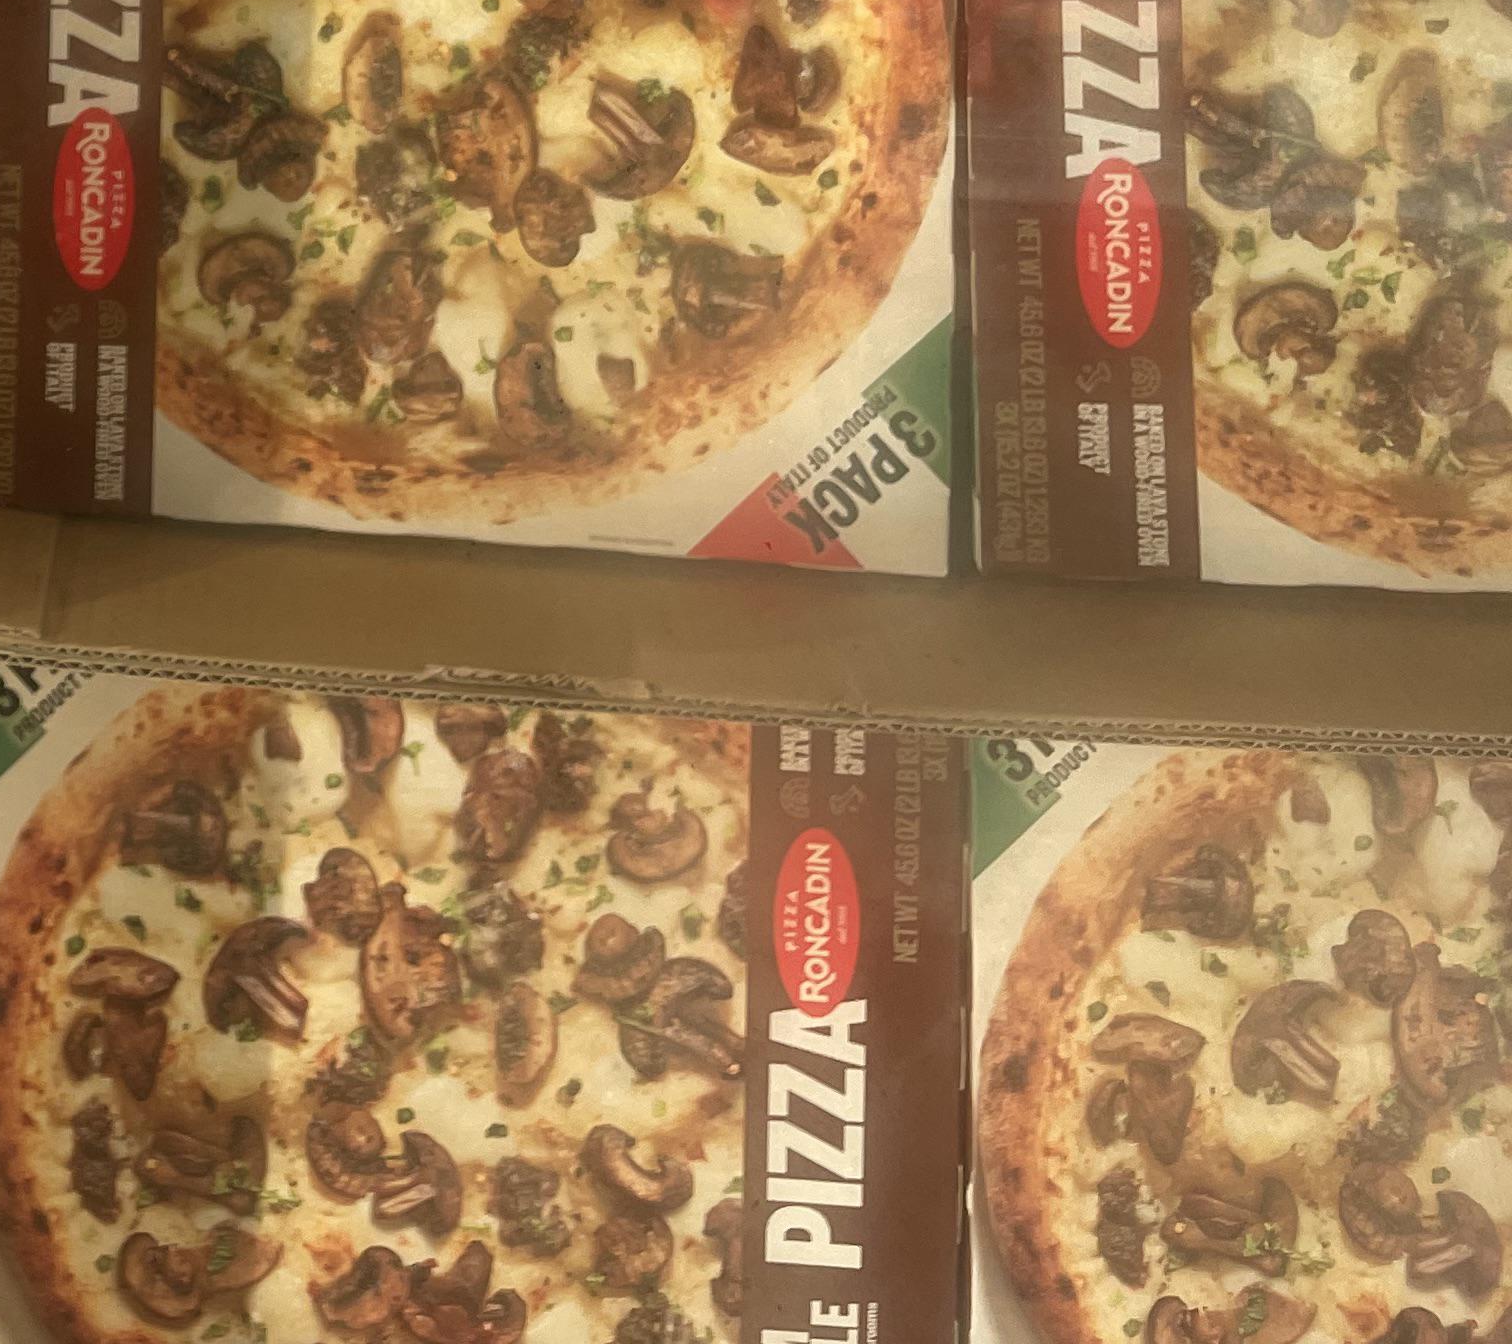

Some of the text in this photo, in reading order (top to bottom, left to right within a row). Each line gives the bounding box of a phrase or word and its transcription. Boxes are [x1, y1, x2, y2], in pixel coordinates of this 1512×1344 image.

[74, 121, 110, 276] RONCADIN
[110, 170, 125, 229] PIZZA
[1015, 218, 1040, 256] NET
[1096, 172, 1133, 334] RONCADIN
[1135, 222, 1151, 284] PIZZA
[1017, 258, 1042, 289] WT
[43, 363, 59, 402] ITALY
[1021, 388, 1046, 413] LB
[766, 384, 897, 508] PRODUCT OF ITALY
[889, 410, 936, 458] 3
[1076, 424, 1093, 469] ITALY
[1090, 403, 1109, 476] PRODUCT
[784, 433, 910, 553] PACK
[988, 739, 1034, 782] 3
[783, 889, 799, 951] PIZZA
[800, 842, 837, 1003] RONCADIN
[892, 890, 919, 921] WT
[893, 923, 919, 962] NET
[764, 998, 867, 1269] PIZZA
